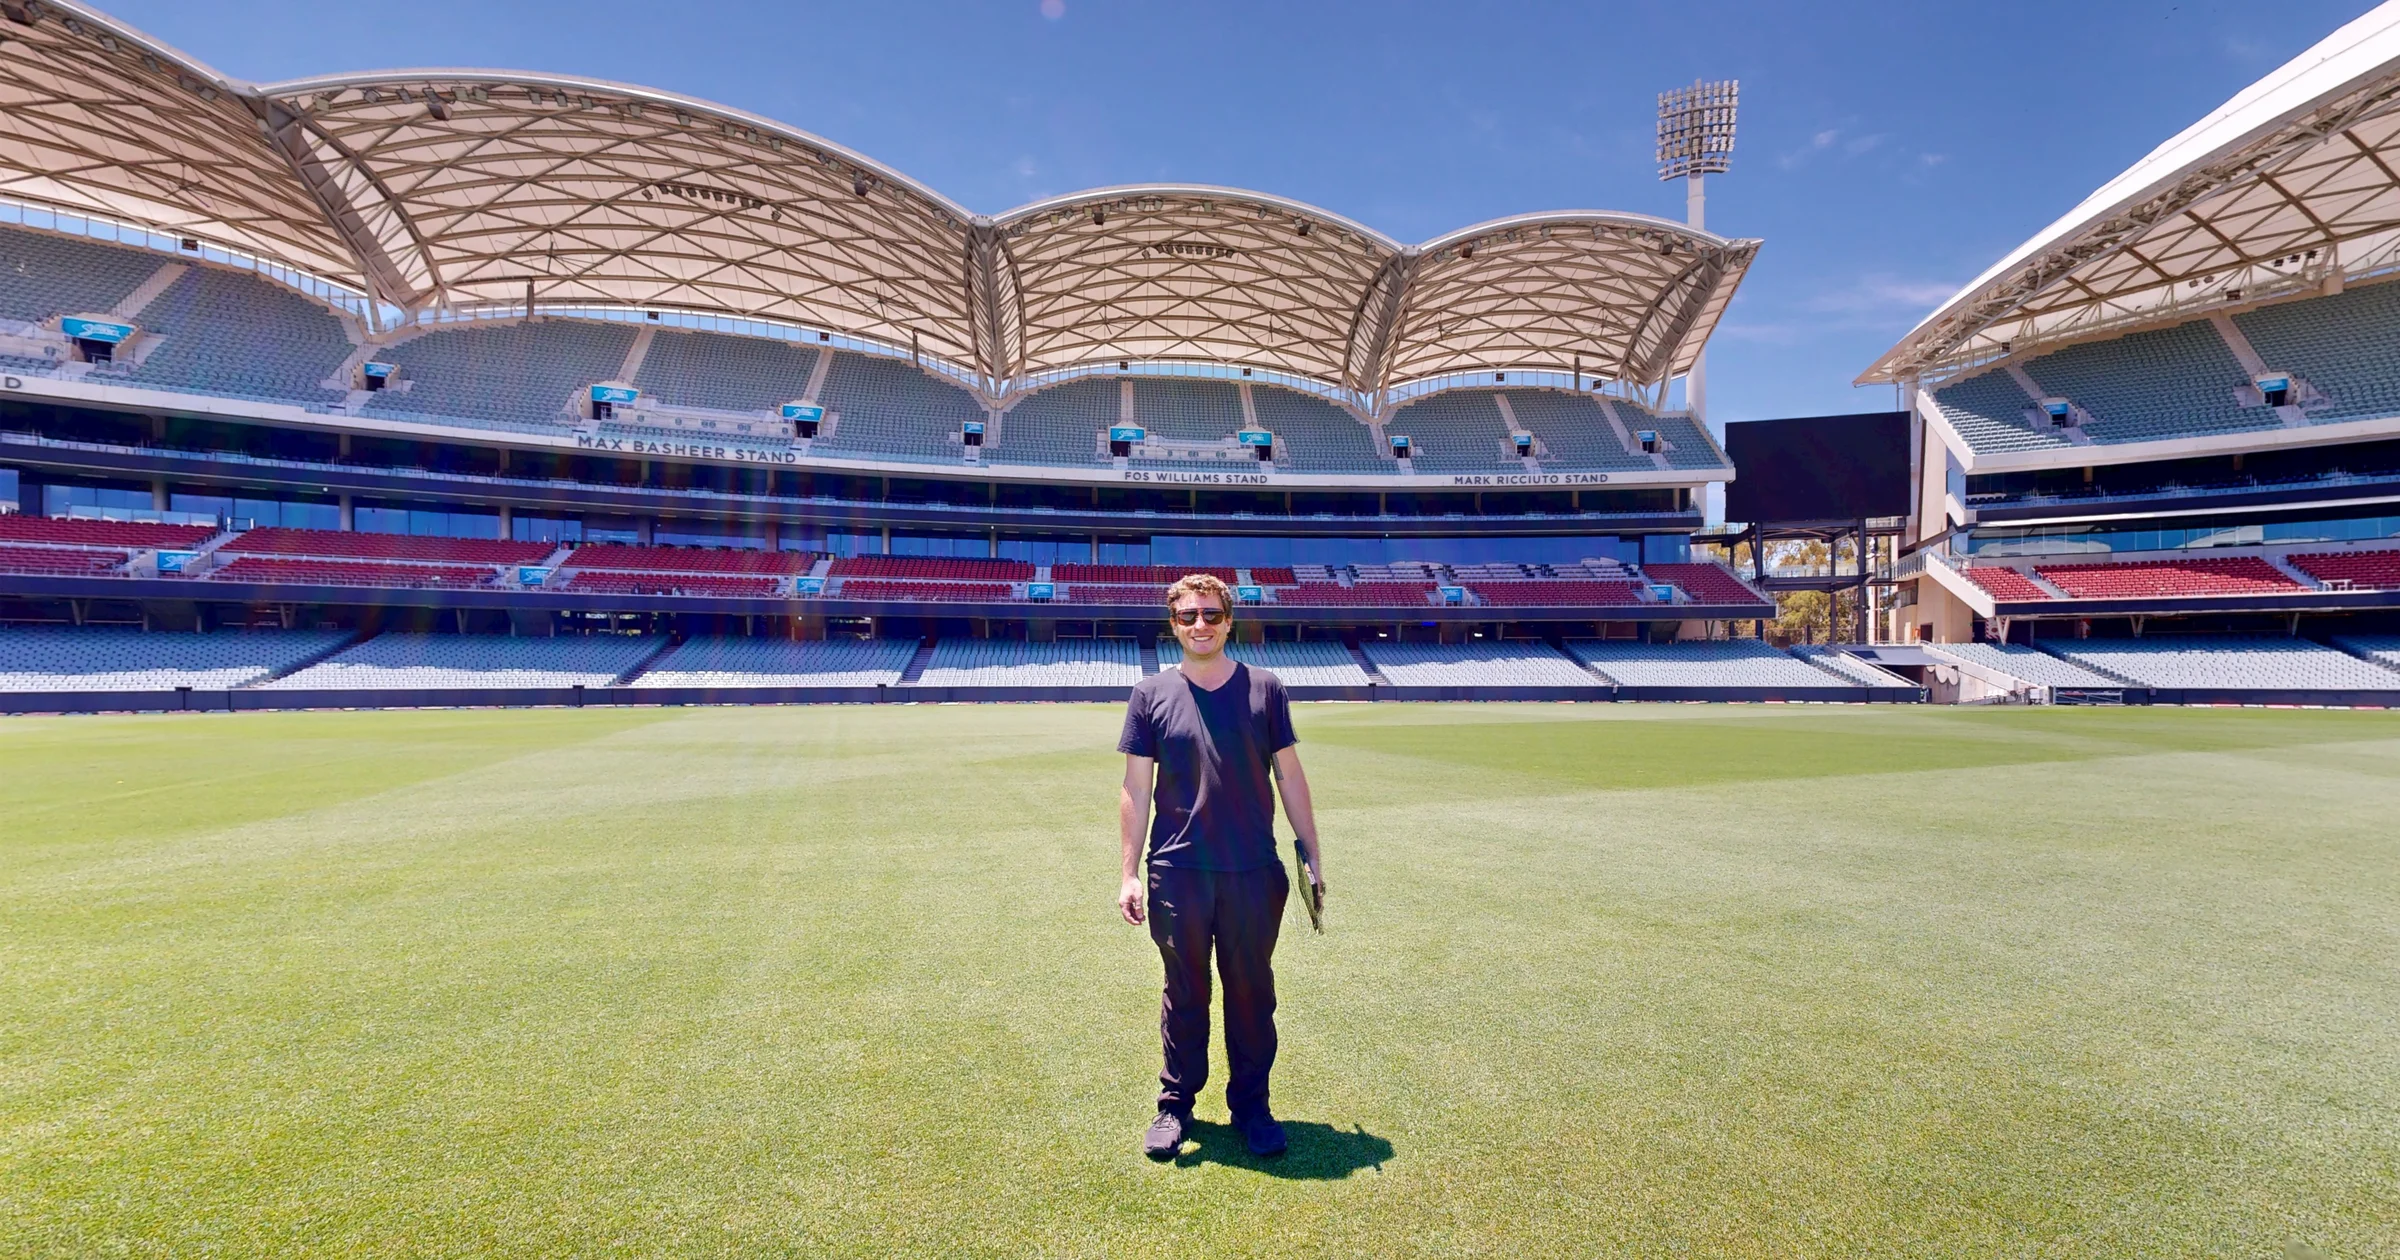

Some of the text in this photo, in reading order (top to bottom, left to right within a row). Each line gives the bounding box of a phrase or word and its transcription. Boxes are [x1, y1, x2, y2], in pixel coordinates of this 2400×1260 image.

[578, 435, 796, 463] MAX BASHEER STAND
[1124, 471, 1268, 484] FOS WILLIAMS STAND
[1454, 474, 1609, 485] MARK RICCIUTO STAND
